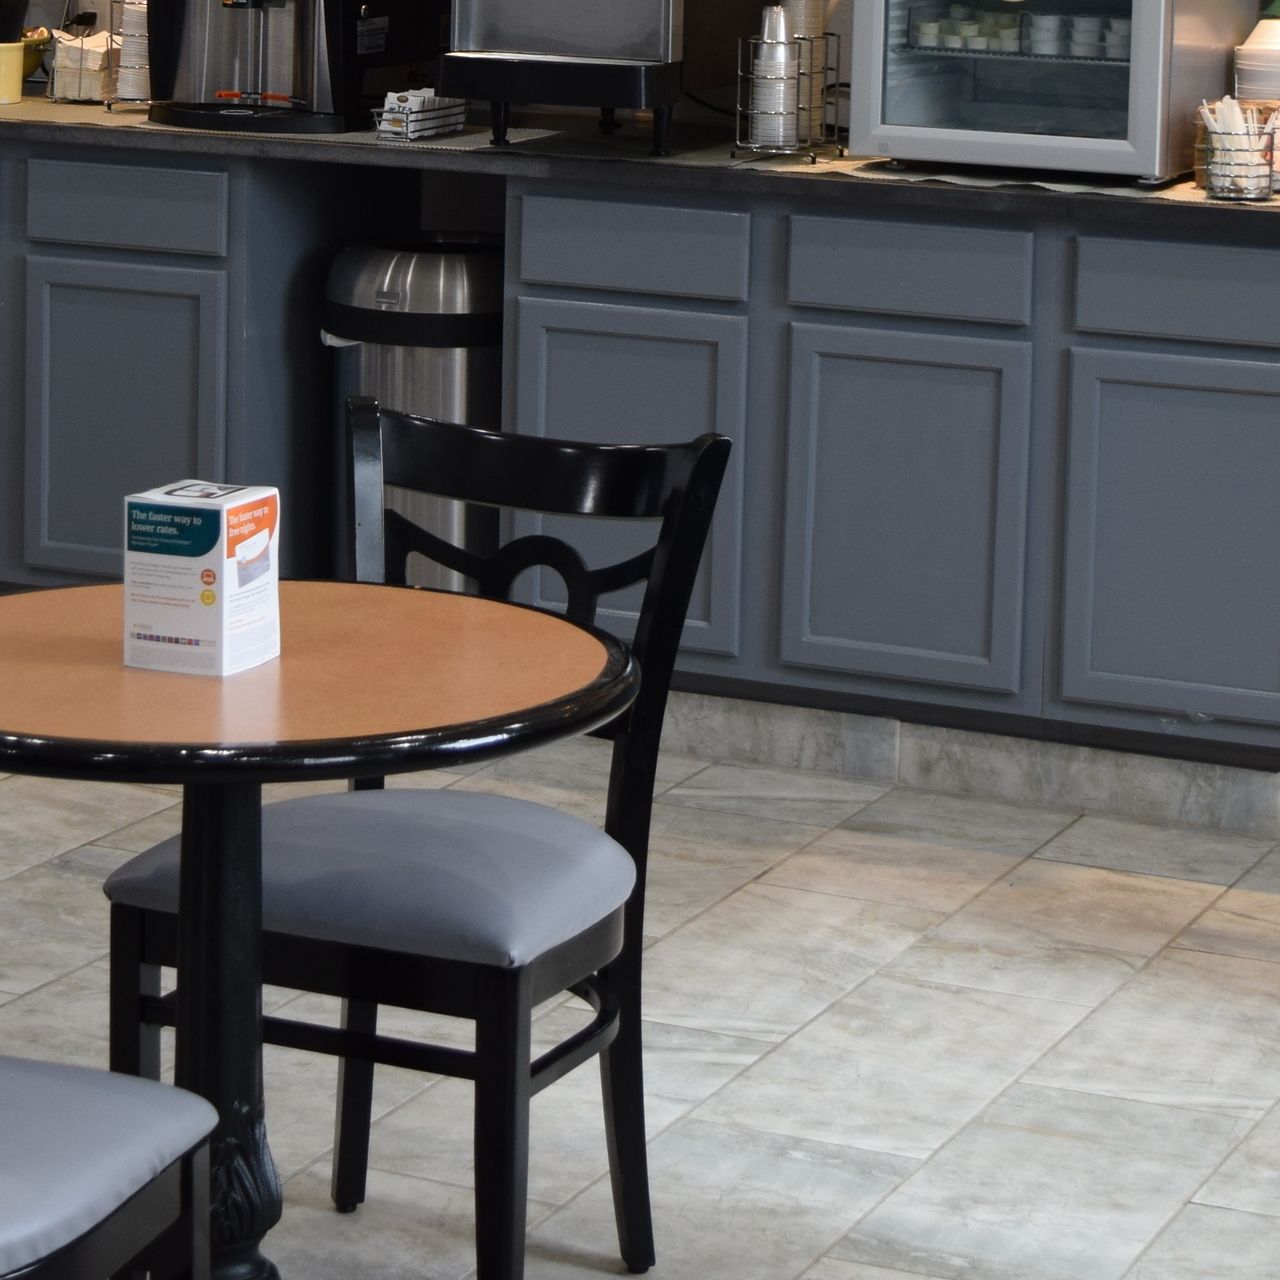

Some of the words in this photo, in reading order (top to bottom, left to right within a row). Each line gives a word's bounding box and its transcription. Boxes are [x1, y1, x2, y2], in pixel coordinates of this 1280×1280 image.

[131, 510, 147, 520] The
[148, 511, 172, 522] faster
[174, 516, 192, 526] way
[193, 516, 202, 526] to
[131, 521, 154, 533] lower
[156, 525, 179, 536] rates.
